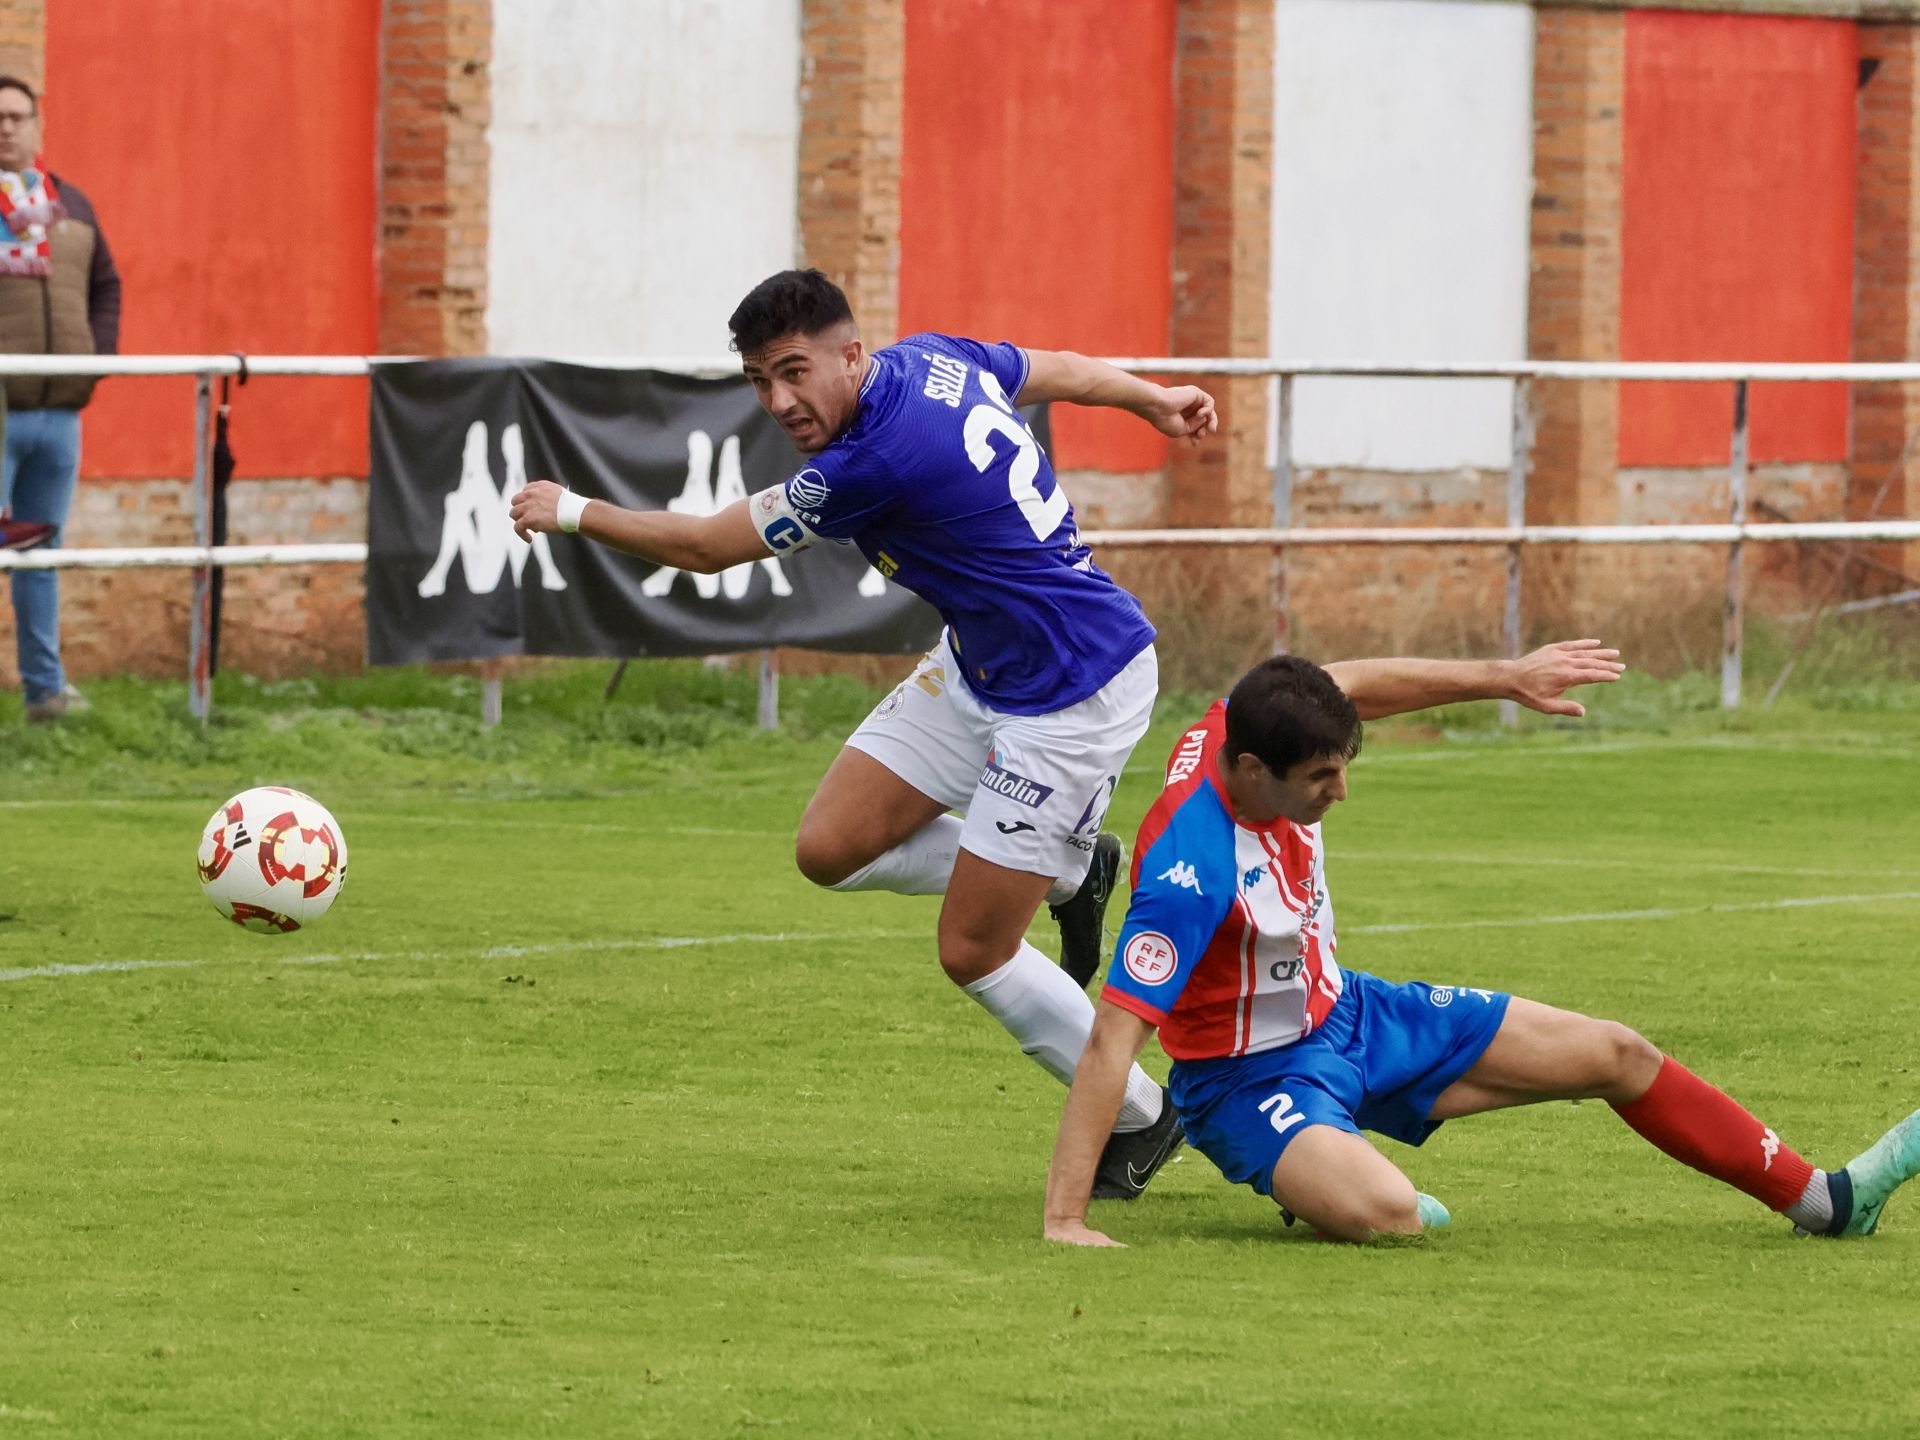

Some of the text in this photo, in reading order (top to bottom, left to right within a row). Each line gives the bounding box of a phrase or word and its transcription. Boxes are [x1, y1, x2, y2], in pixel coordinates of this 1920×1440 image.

[922, 353, 968, 408] SELLÉS
[764, 516, 805, 550] C
[1165, 729, 1208, 787] PITESA
[1257, 1093, 1306, 1135] 2
